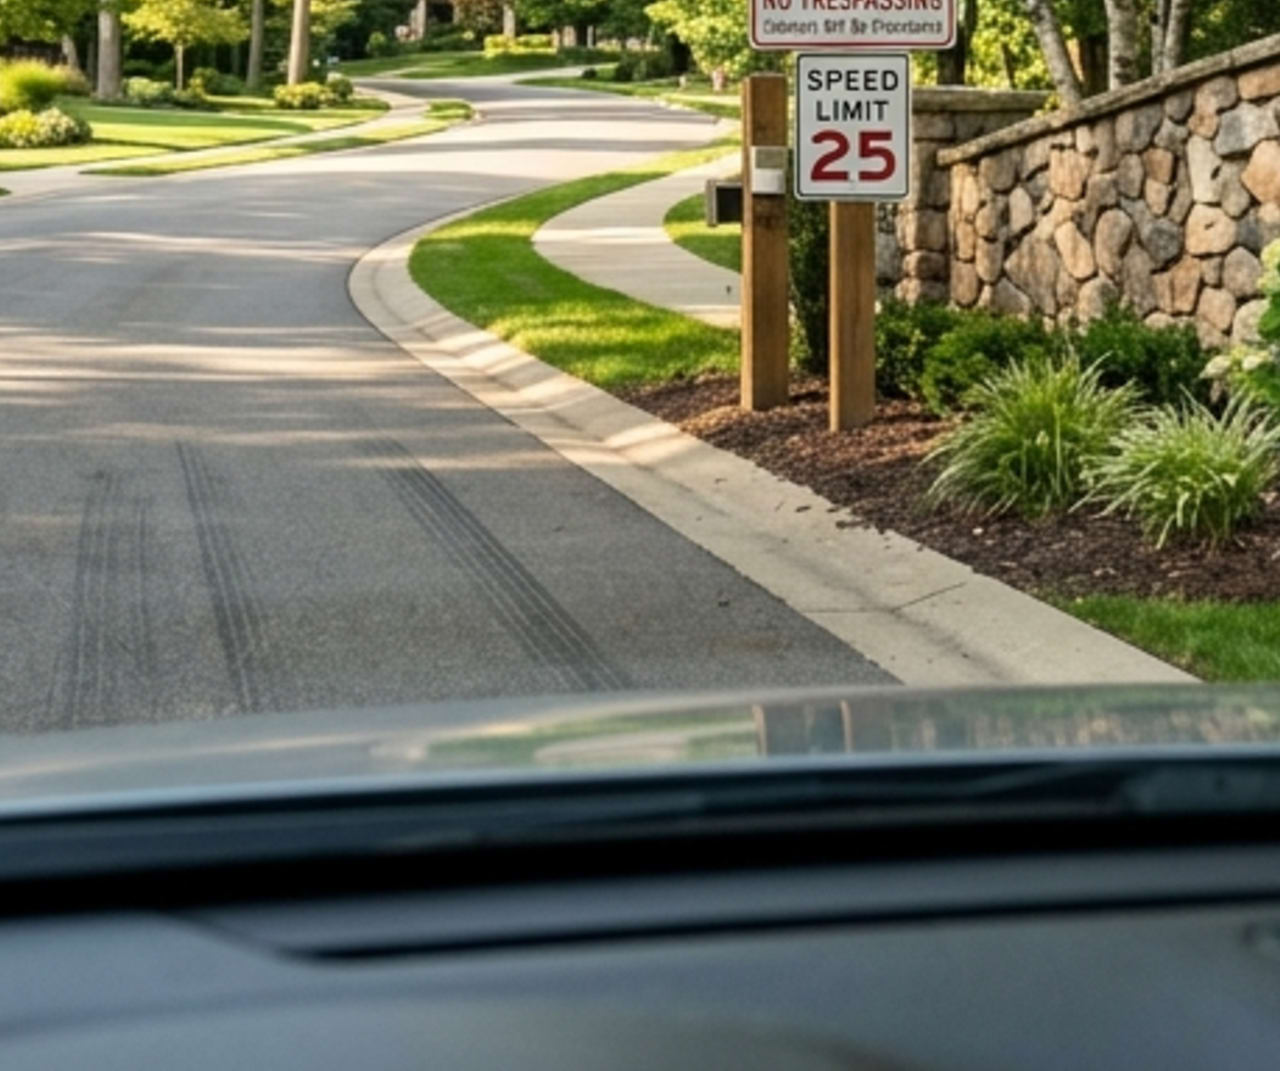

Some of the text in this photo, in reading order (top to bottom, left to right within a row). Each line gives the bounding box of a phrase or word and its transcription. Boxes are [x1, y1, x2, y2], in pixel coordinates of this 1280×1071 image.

[807, 69, 899, 92] SPEED
[816, 100, 889, 122] LIMIT
[810, 129, 896, 183] 25
